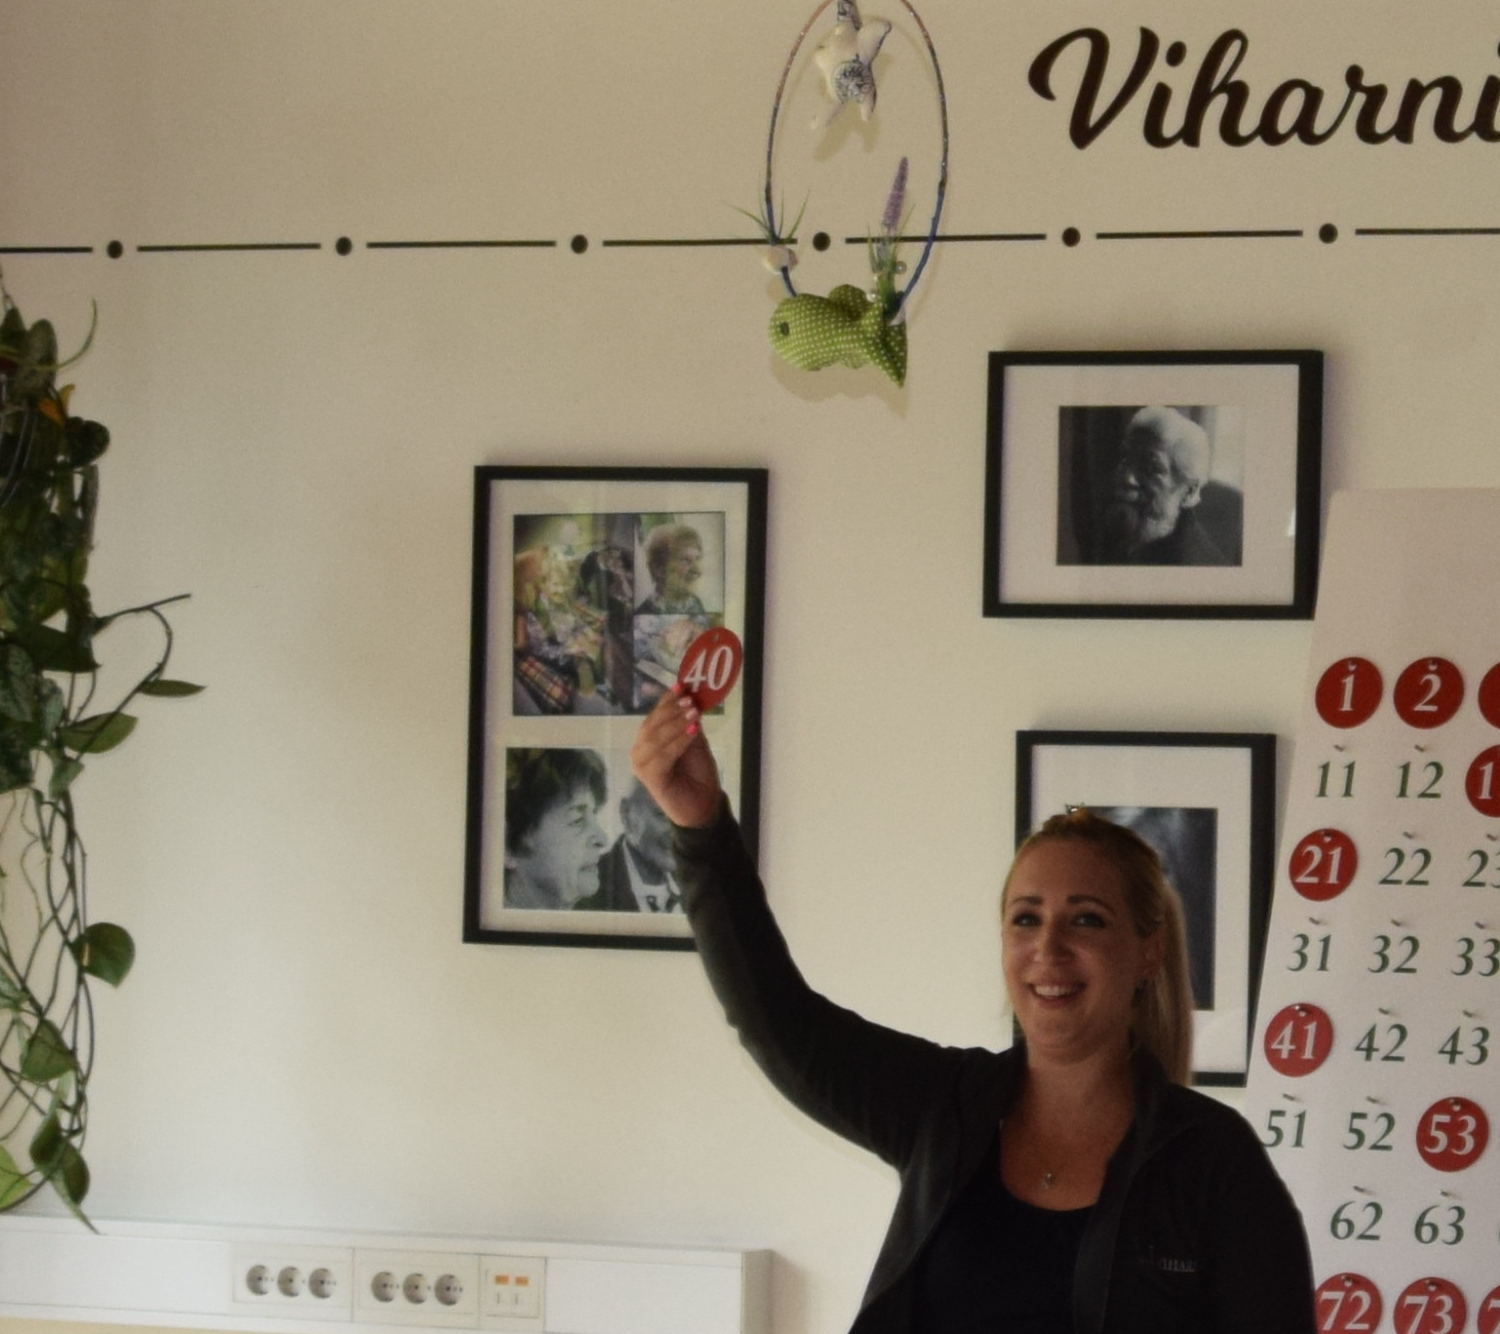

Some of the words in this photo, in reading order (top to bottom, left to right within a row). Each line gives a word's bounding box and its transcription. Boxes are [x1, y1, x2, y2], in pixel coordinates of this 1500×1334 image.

[683, 645, 734, 693] 40
[1339, 674, 1355, 712] 1
[1413, 673, 1442, 712] 2
[1317, 761, 1356, 798] 11
[1397, 761, 1444, 799] 12
[1295, 844, 1342, 884] 21
[1378, 847, 1432, 885] 22
[1289, 933, 1331, 972] 31
[1369, 934, 1420, 974] 32
[1270, 1020, 1317, 1060] 41
[1354, 1023, 1408, 1062] 42
[1438, 1026, 1490, 1066] 43
[1263, 1109, 1307, 1149] 51
[1343, 1111, 1396, 1151] 52
[1424, 1114, 1477, 1156] 53
[1330, 1201, 1383, 1240] 62
[1414, 1205, 1466, 1246] 63
[1320, 1290, 1371, 1331] 72
